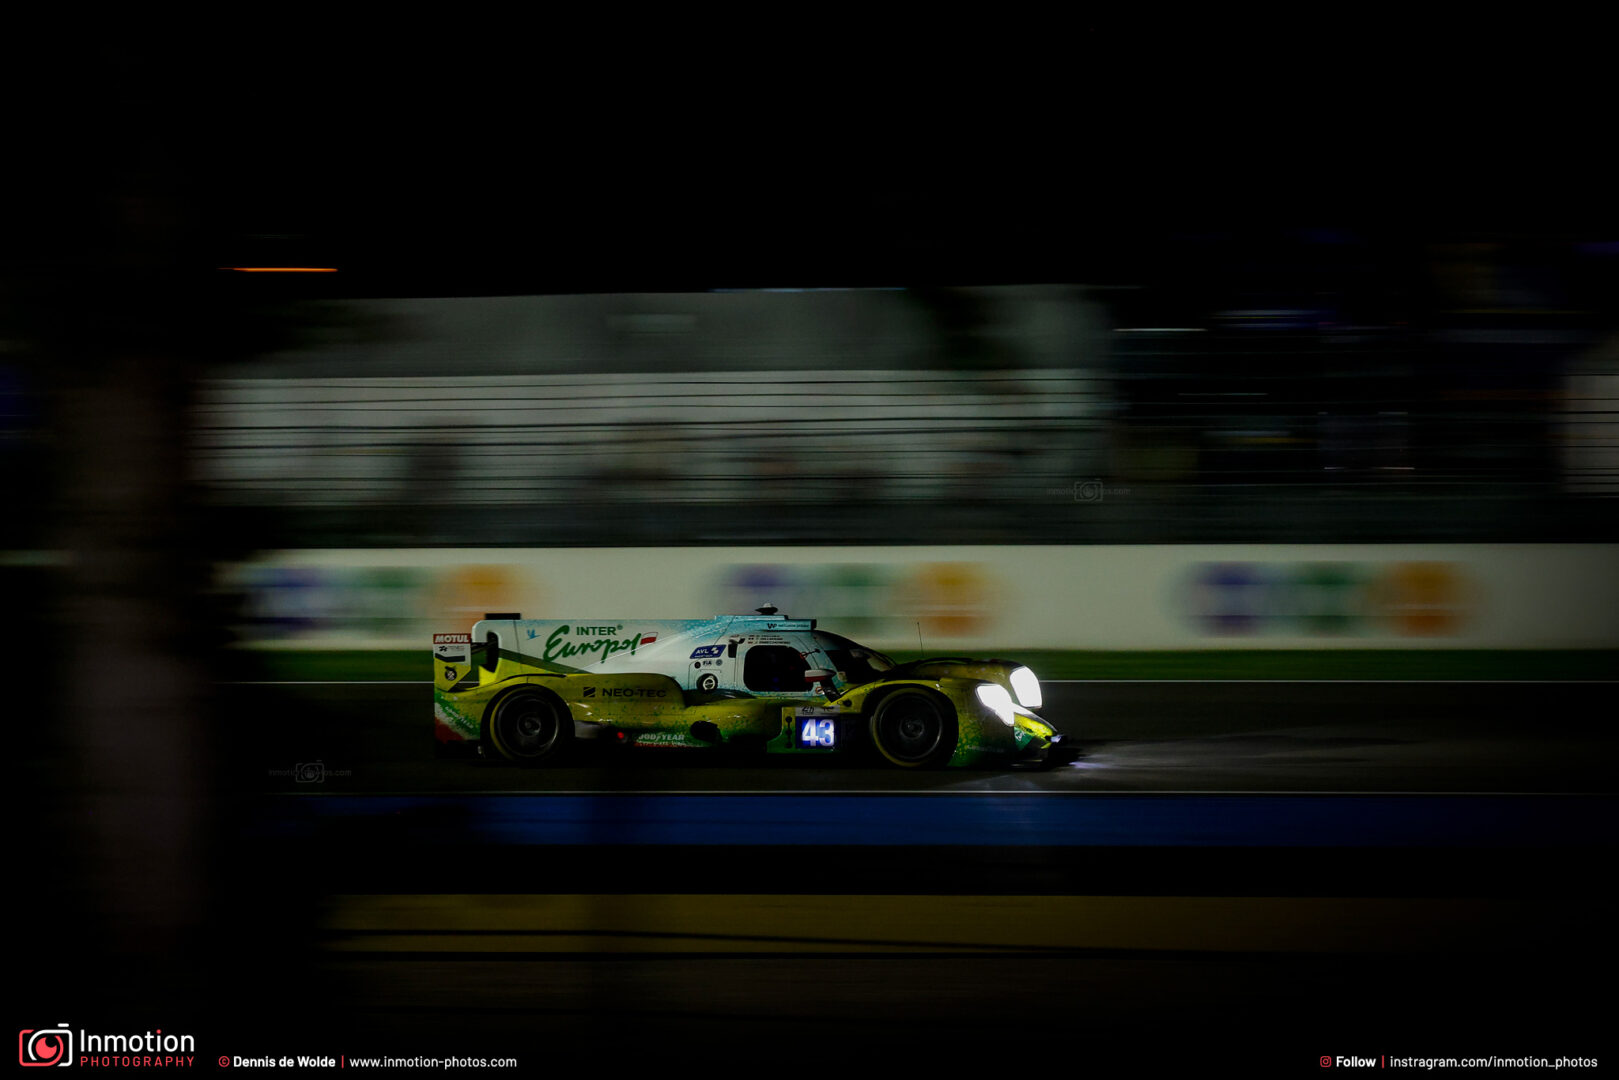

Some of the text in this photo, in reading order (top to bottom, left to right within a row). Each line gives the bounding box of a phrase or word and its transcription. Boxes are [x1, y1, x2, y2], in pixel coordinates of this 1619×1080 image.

[435, 635, 470, 643] MOTUL
[543, 625, 641, 663] Europol
[602, 688, 666, 698] NEO-TEC
[801, 718, 835, 747] 43
